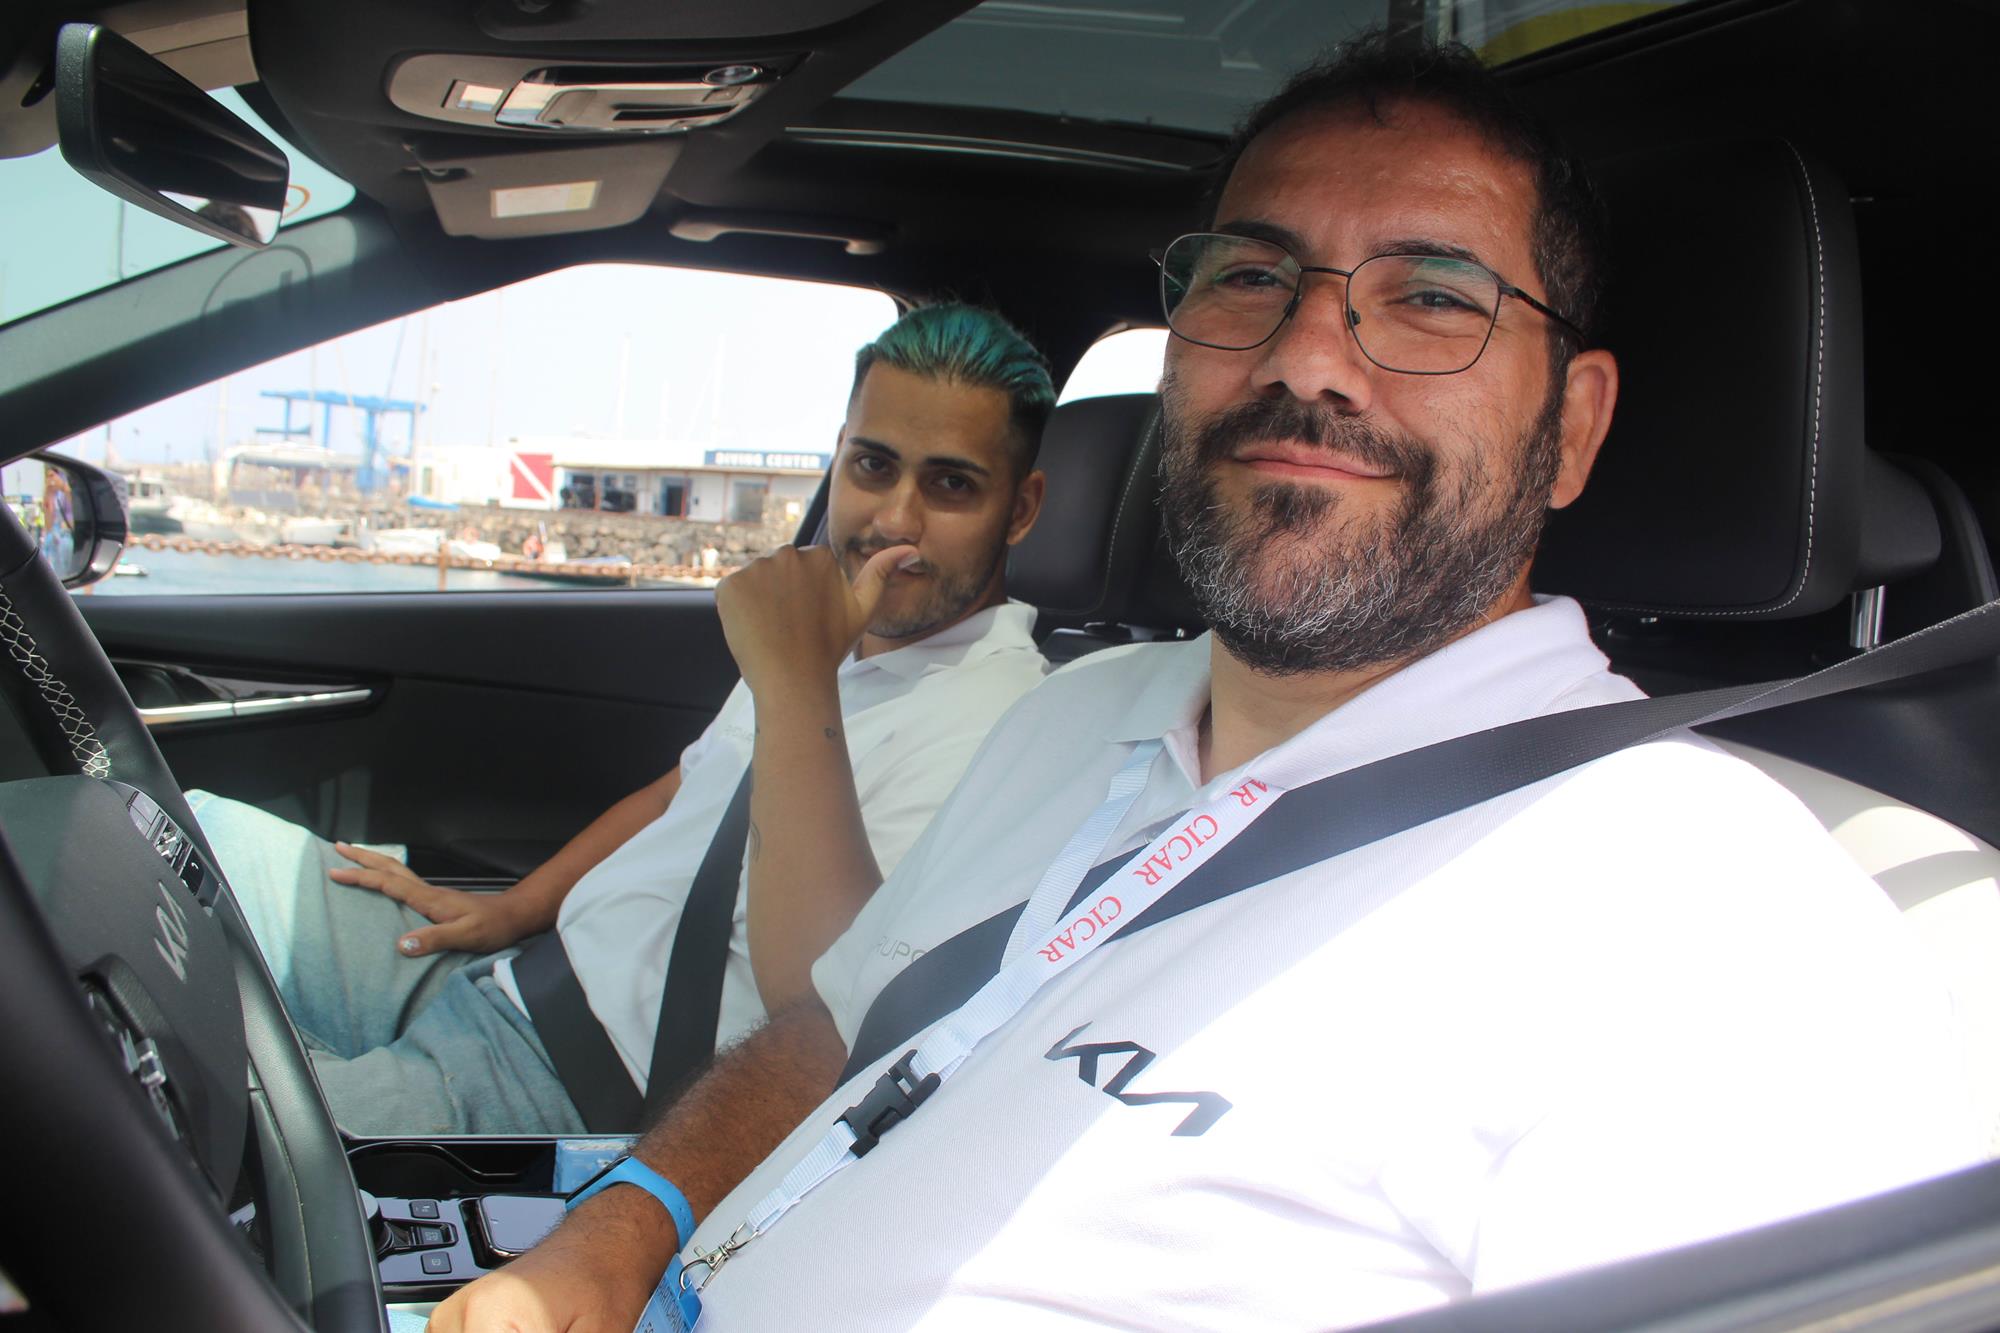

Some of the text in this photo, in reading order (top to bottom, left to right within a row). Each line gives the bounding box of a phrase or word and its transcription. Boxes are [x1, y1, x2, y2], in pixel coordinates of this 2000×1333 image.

[766, 454, 821, 468] CENTER
[1133, 814, 1218, 886] CICAR
[1037, 895, 1123, 964] CICAR
